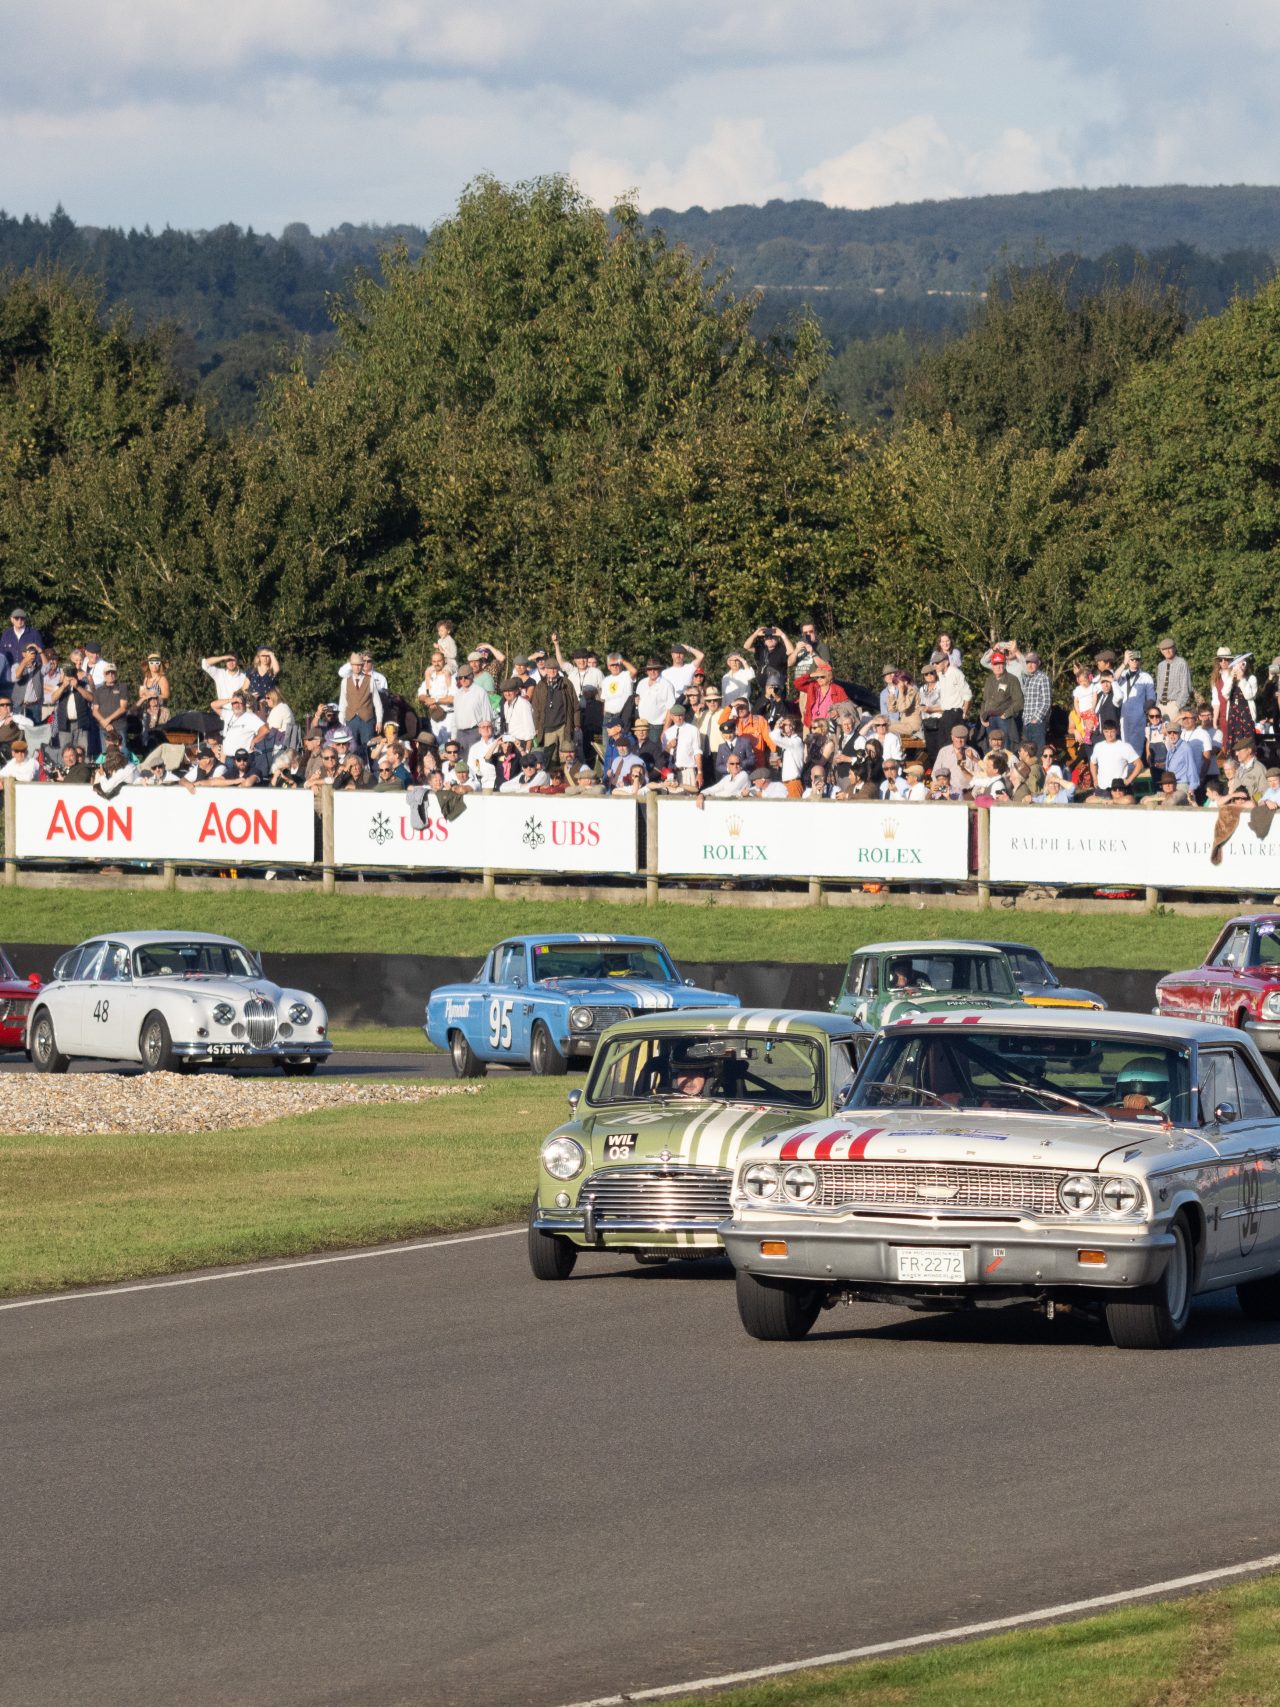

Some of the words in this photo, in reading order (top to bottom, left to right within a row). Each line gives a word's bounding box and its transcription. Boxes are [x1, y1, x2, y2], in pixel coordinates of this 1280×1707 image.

[46, 799, 132, 842] AON
[198, 801, 278, 845] AON
[552, 820, 601, 846] UBS
[702, 844, 768, 861] ROLEX
[1011, 837, 1060, 851] RALPH
[1067, 838, 1128, 852] LAUREN
[1173, 840, 1212, 854] RALP
[858, 848, 922, 864] ROLEX
[93, 1000, 110, 1023] 48
[489, 999, 514, 1049] 95
[207, 1044, 231, 1055] 4576
[232, 1044, 245, 1054] NK
[608, 1134, 635, 1146] WIL
[609, 1146, 630, 1160] 03
